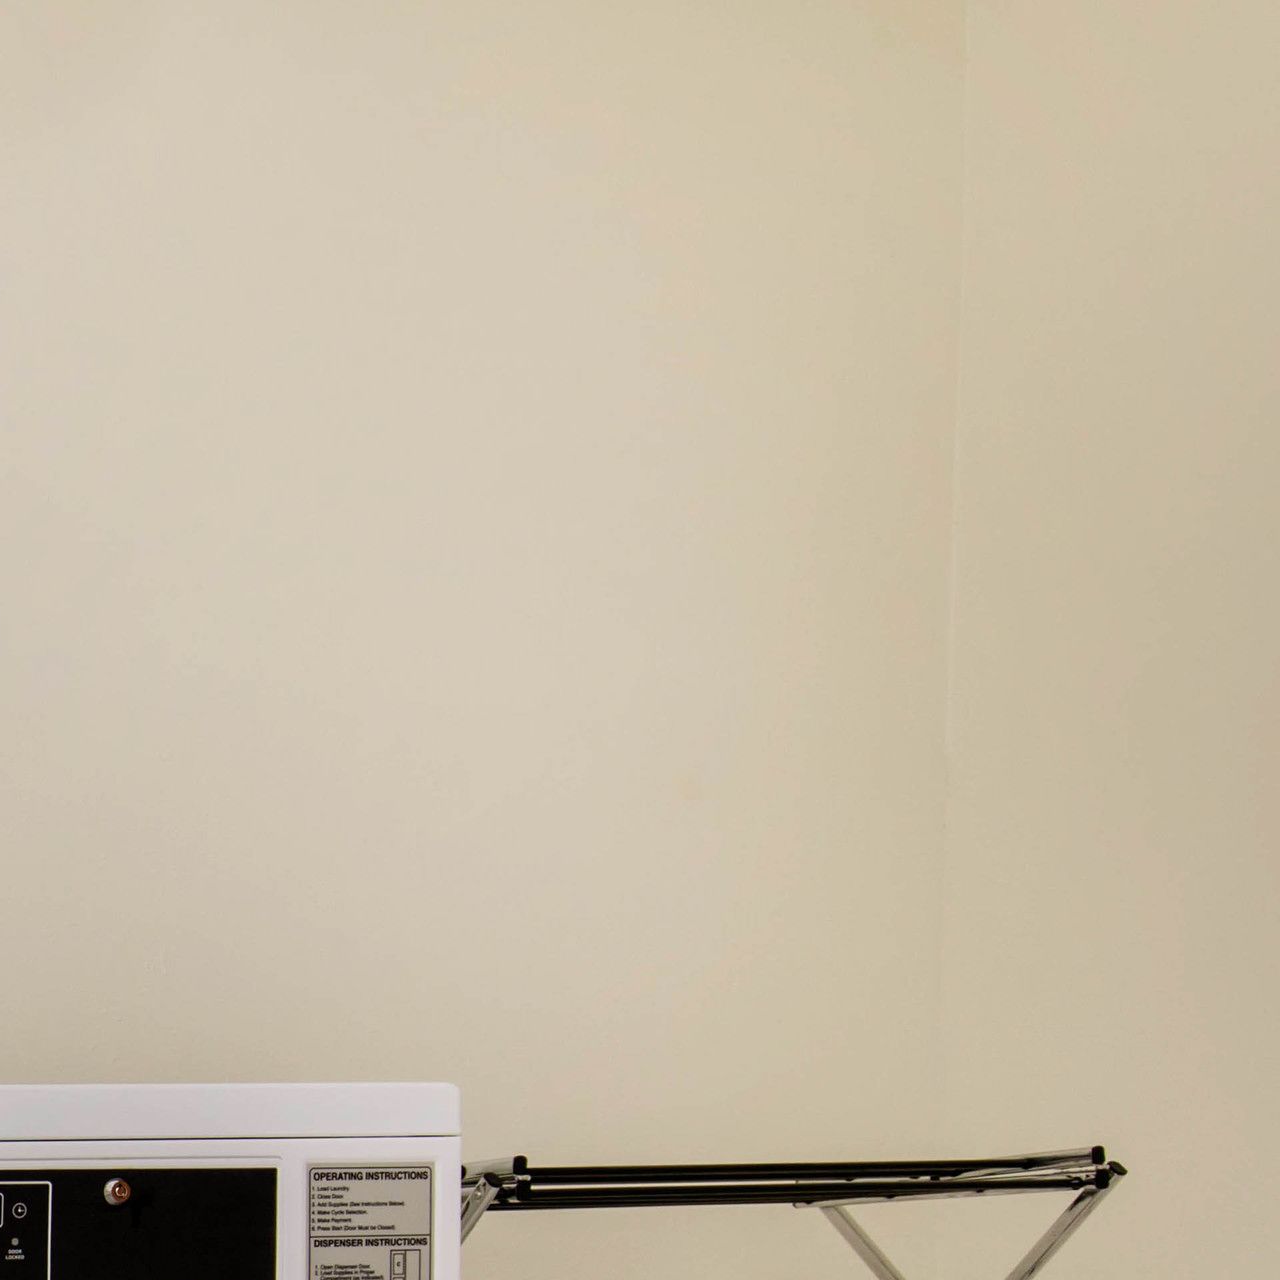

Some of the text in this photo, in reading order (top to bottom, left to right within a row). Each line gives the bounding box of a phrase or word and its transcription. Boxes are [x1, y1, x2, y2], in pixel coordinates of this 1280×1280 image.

[313, 1171, 429, 1181] OPERATING INSTRUCTIONS
[313, 1238, 428, 1248] DISPENSER INSTRUCTIONS
